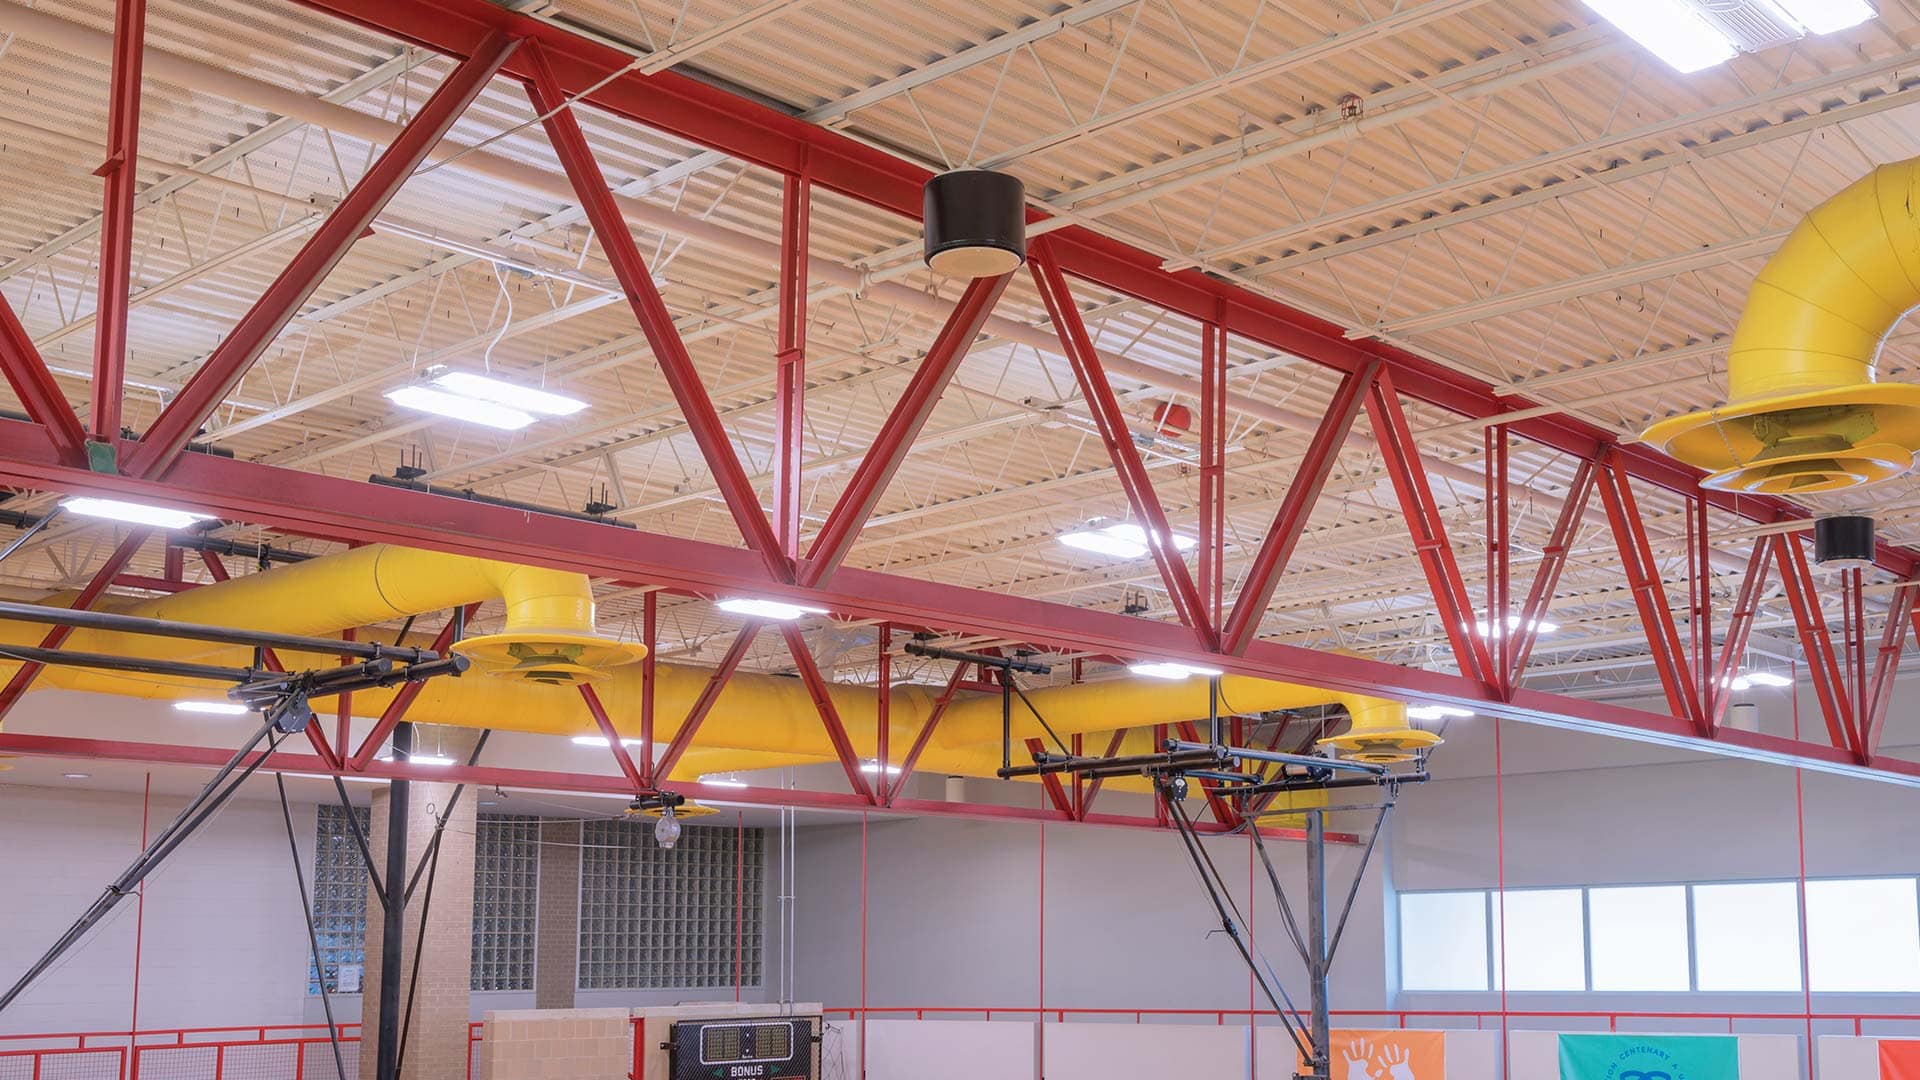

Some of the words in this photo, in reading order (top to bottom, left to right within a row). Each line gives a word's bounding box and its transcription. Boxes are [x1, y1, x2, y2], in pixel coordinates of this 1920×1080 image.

[731, 1065, 763, 1077] BONUS
[1604, 1062, 1618, 1080] ION
[1619, 1046, 1671, 1060] CENTENARY
